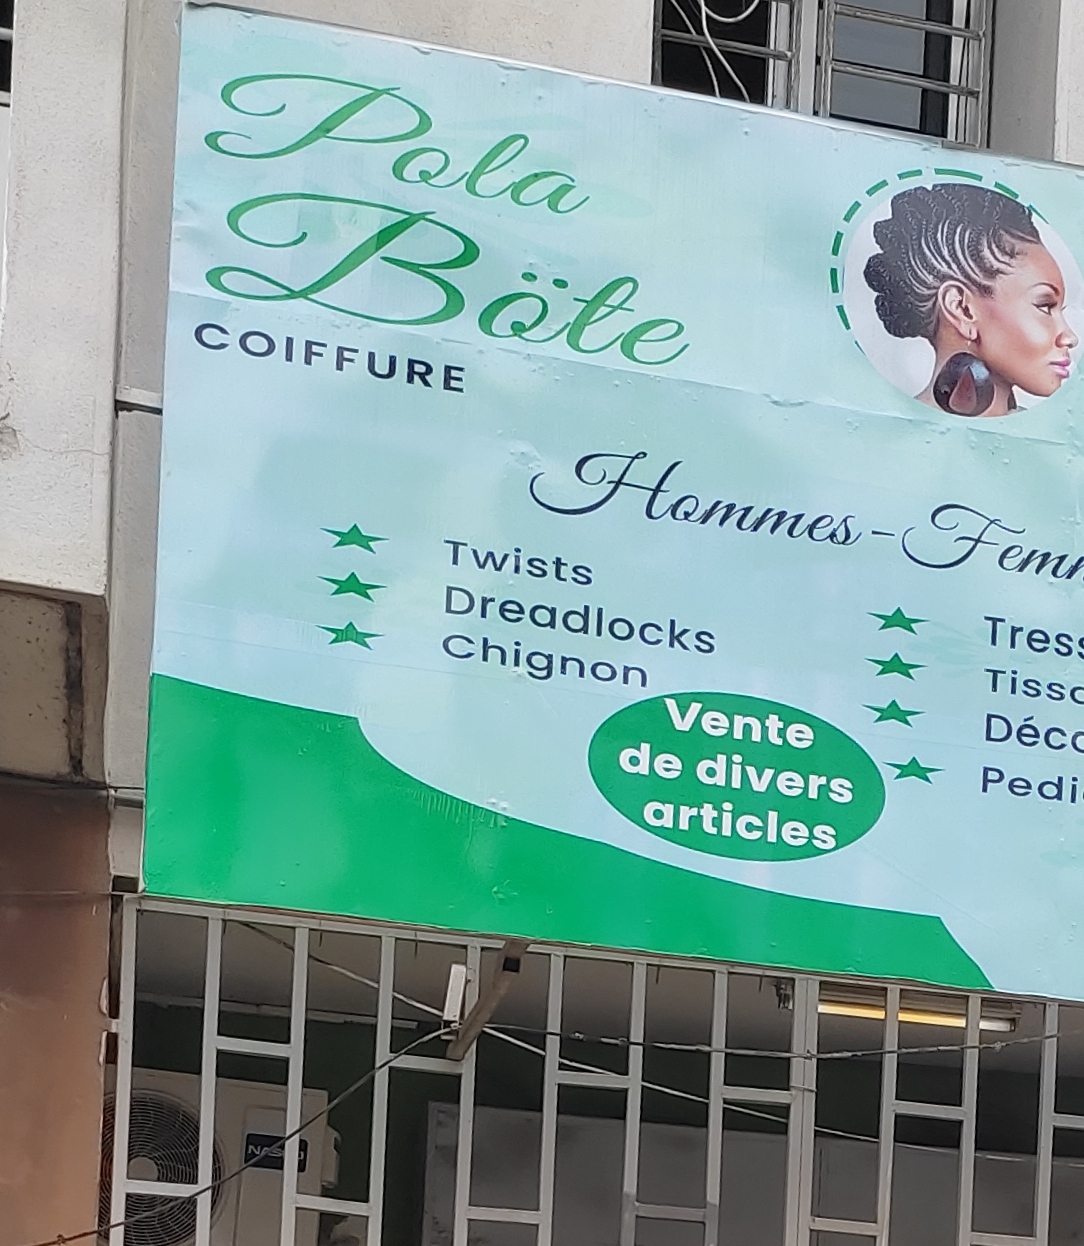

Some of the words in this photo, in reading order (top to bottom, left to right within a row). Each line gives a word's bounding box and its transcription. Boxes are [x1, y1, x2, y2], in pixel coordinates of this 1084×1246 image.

[204, 73, 590, 214] Pola
[205, 192, 690, 365] Böte
[194, 322, 466, 393] COIFFURE
[443, 539, 594, 586] Twists
[444, 586, 717, 654] Dreadlocks
[442, 634, 649, 688] Chignon
[664, 697, 815, 748] Vente
[618, 743, 683, 780] de
[696, 754, 854, 803] divers
[643, 800, 838, 850] articles
